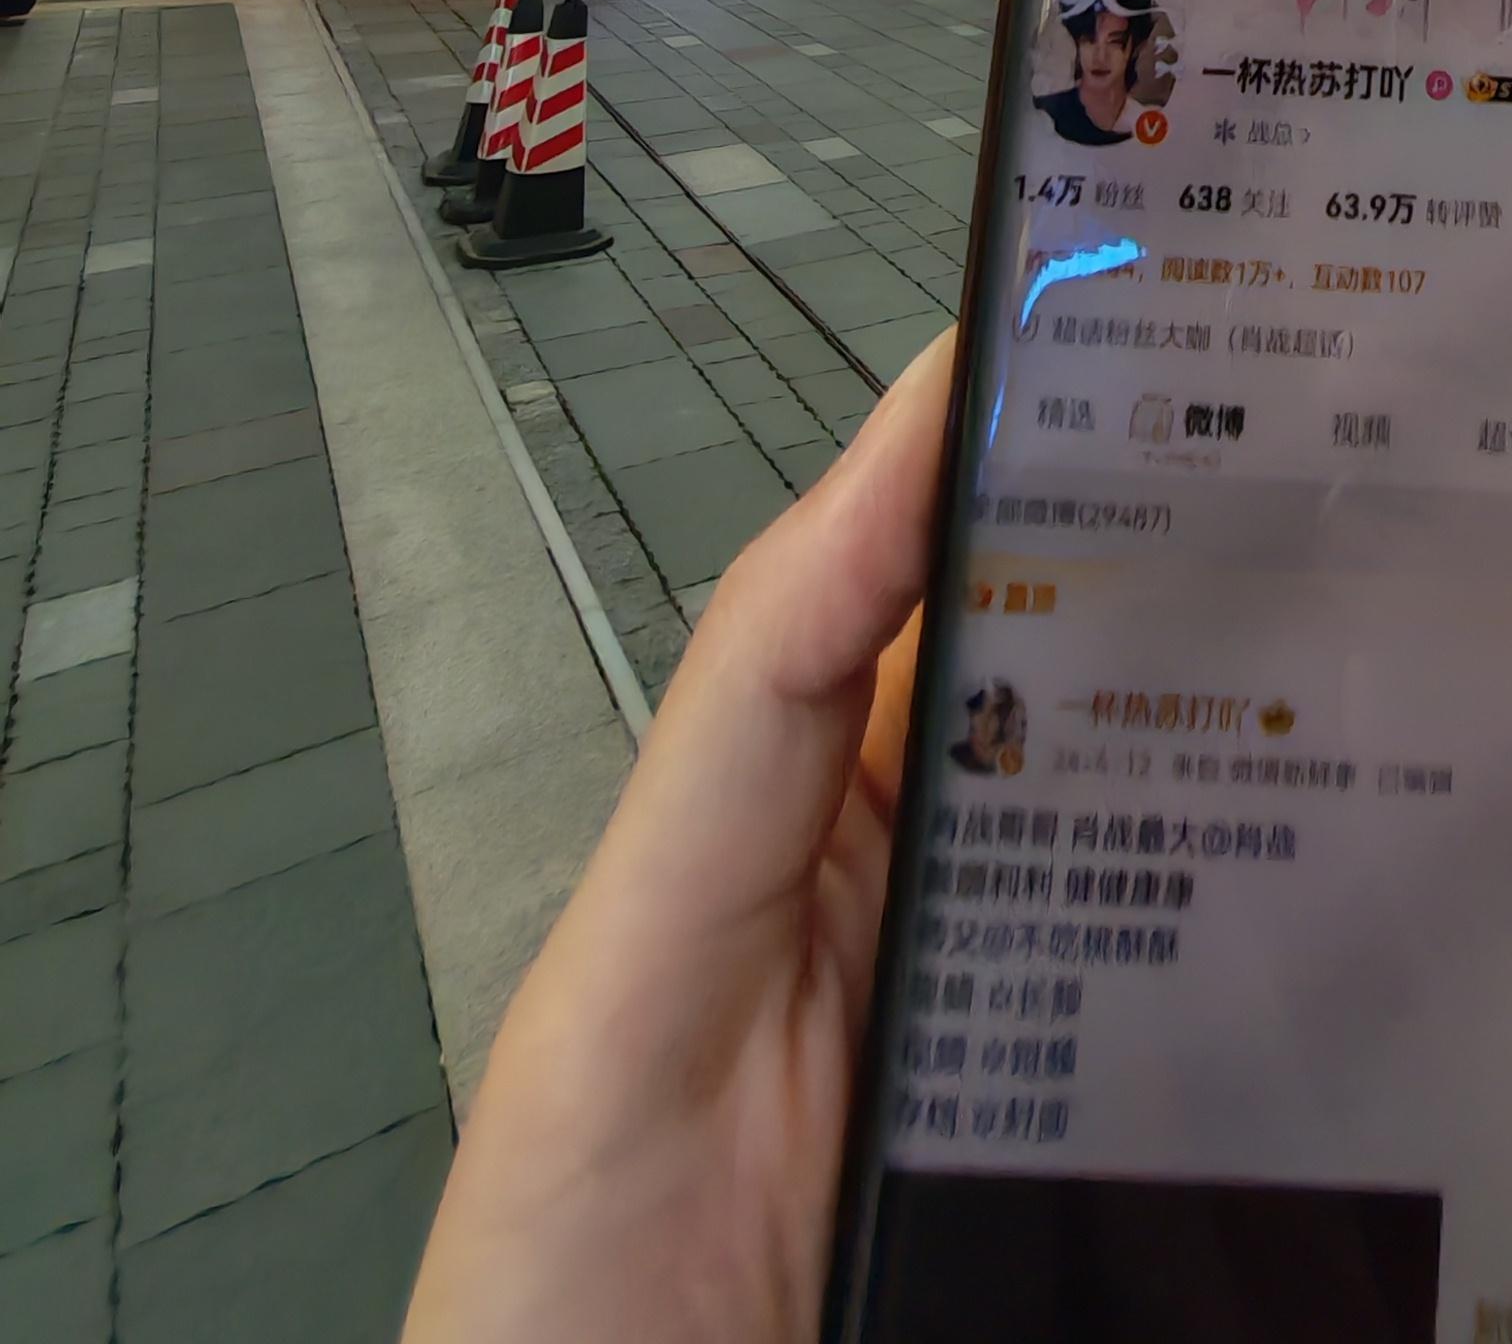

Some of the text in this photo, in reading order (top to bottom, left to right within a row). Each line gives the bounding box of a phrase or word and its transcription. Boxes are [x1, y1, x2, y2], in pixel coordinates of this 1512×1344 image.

[1202, 56, 1414, 102] 一杯热苏打吖
[1014, 174, 1087, 207] 1.4万
[1178, 184, 1232, 212] 638
[1325, 192, 1417, 225] 63.9万
[1184, 401, 1246, 441] 微博
